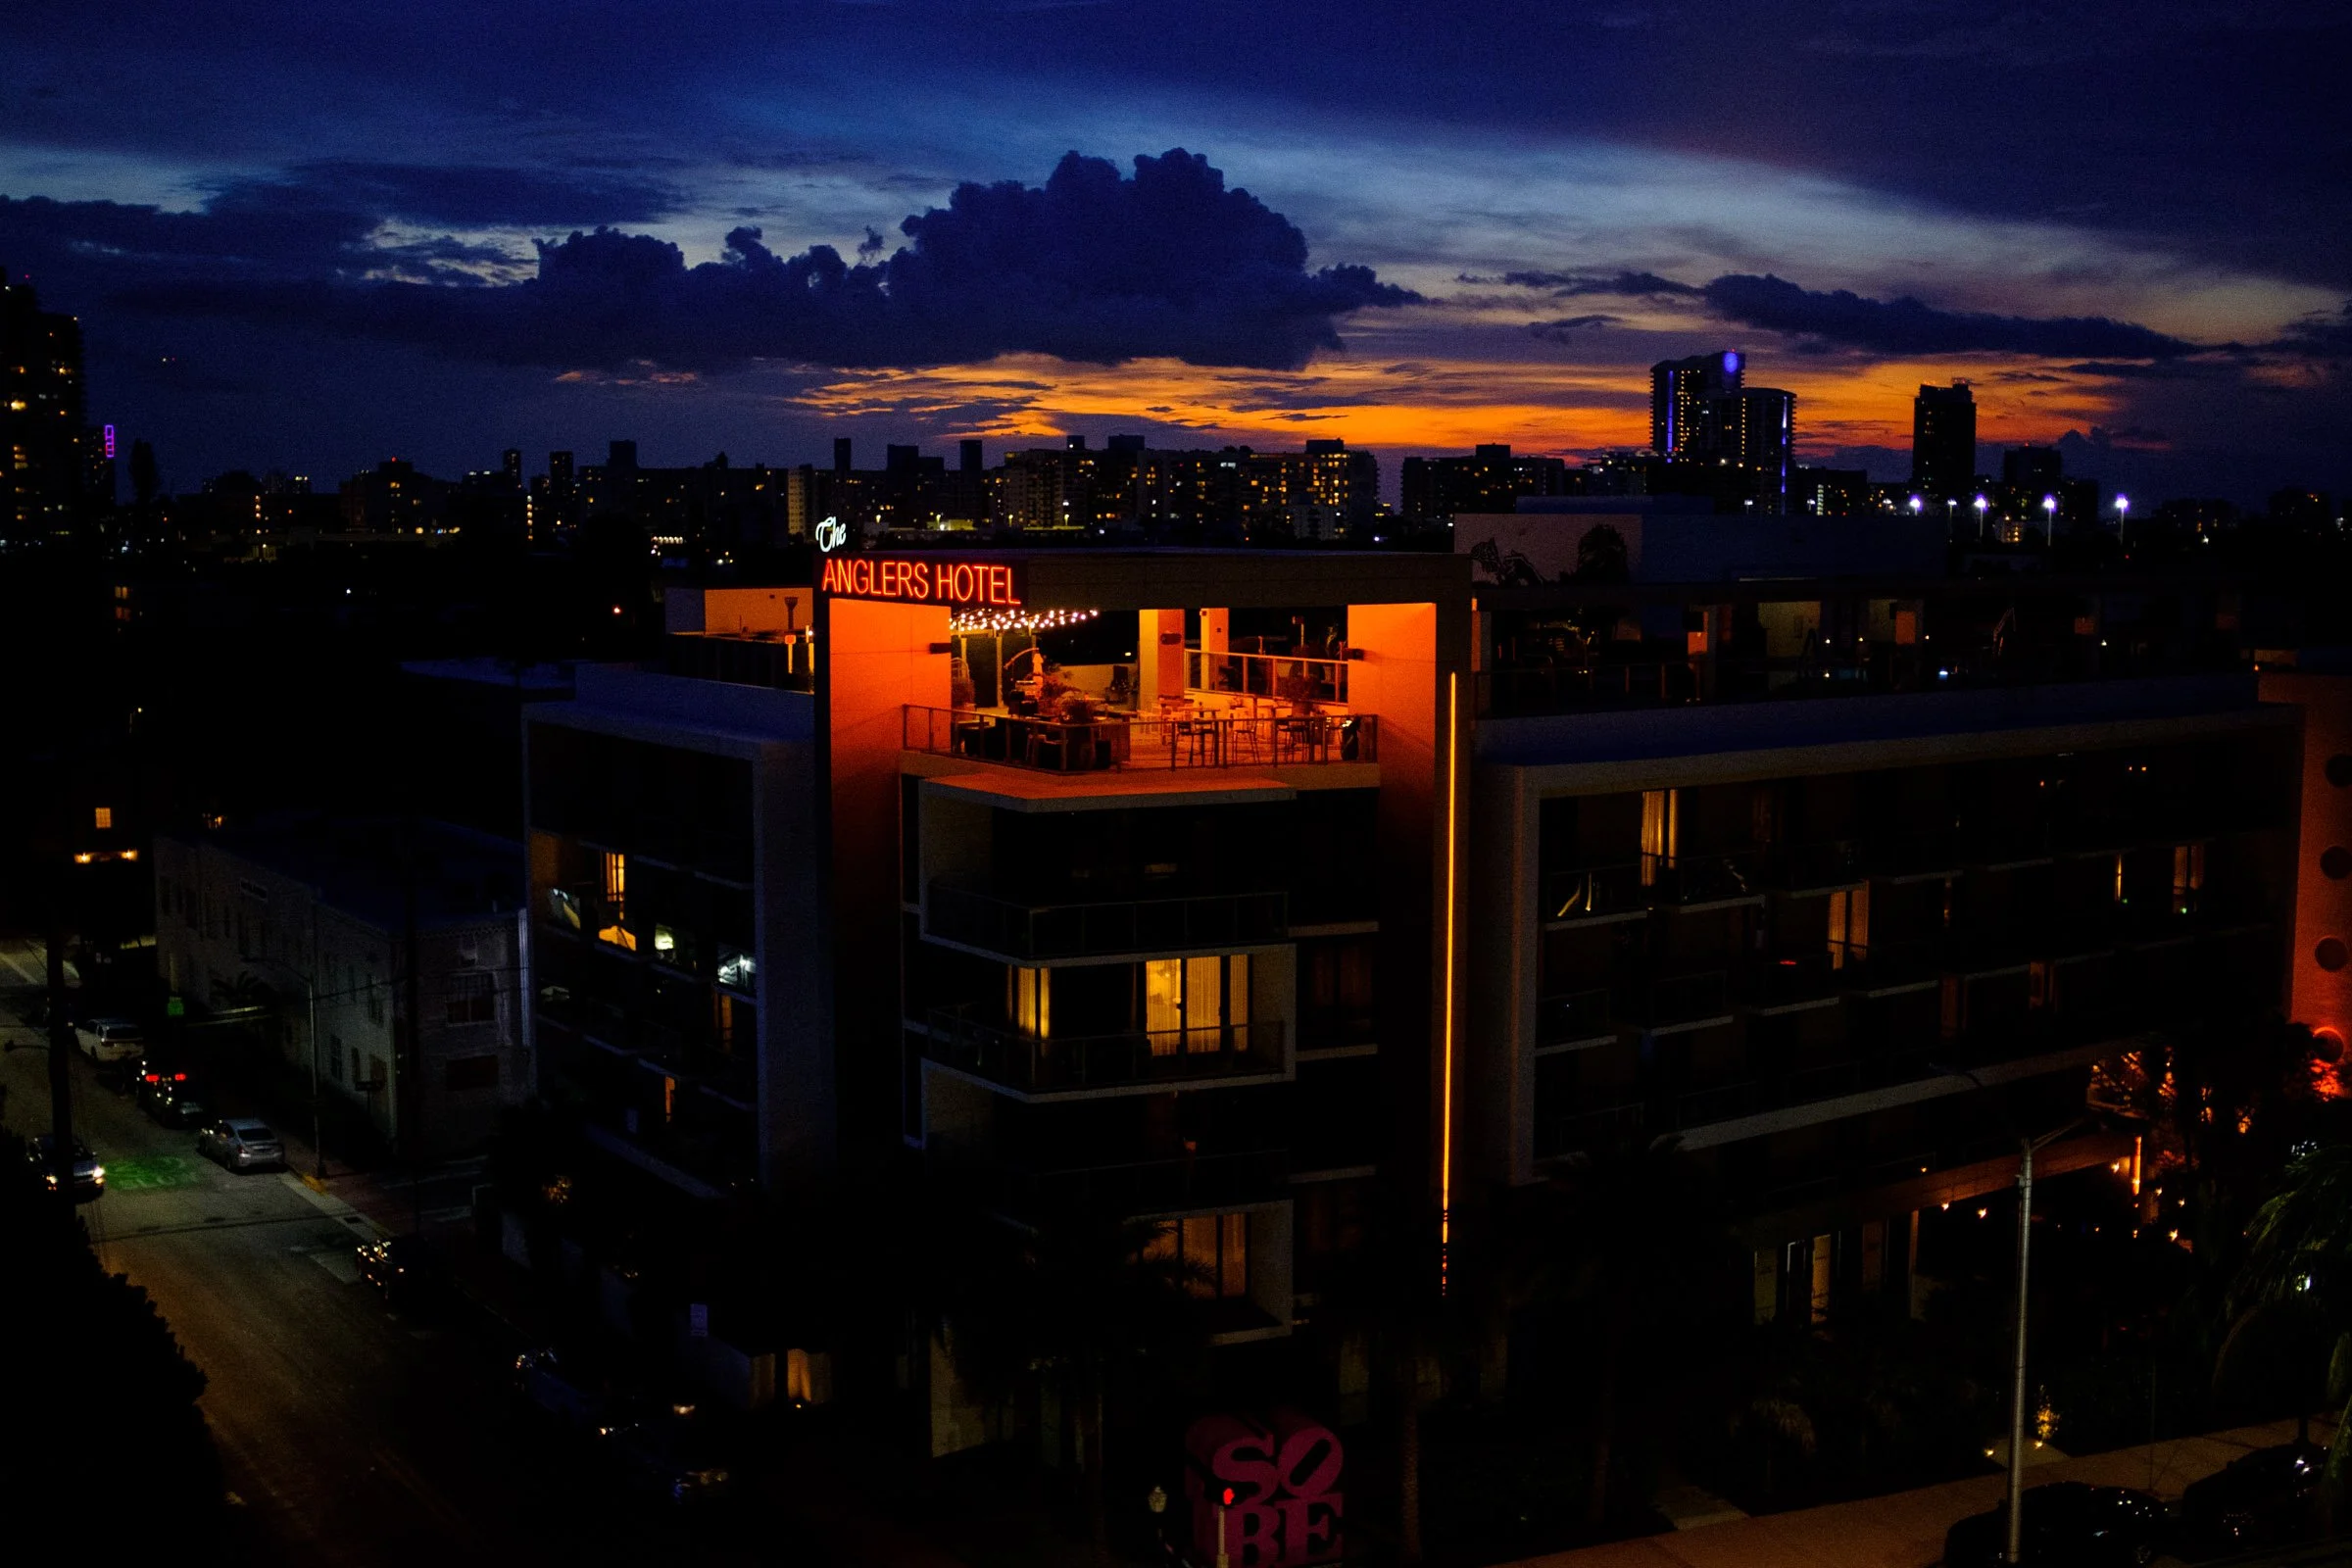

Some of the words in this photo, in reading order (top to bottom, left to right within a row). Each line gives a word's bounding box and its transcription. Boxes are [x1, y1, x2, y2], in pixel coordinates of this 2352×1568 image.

[815, 515, 847, 553] The
[822, 558, 930, 600] ANGLERS
[936, 564, 1022, 606] HOTEL
[1211, 1427, 1345, 1506] SO
